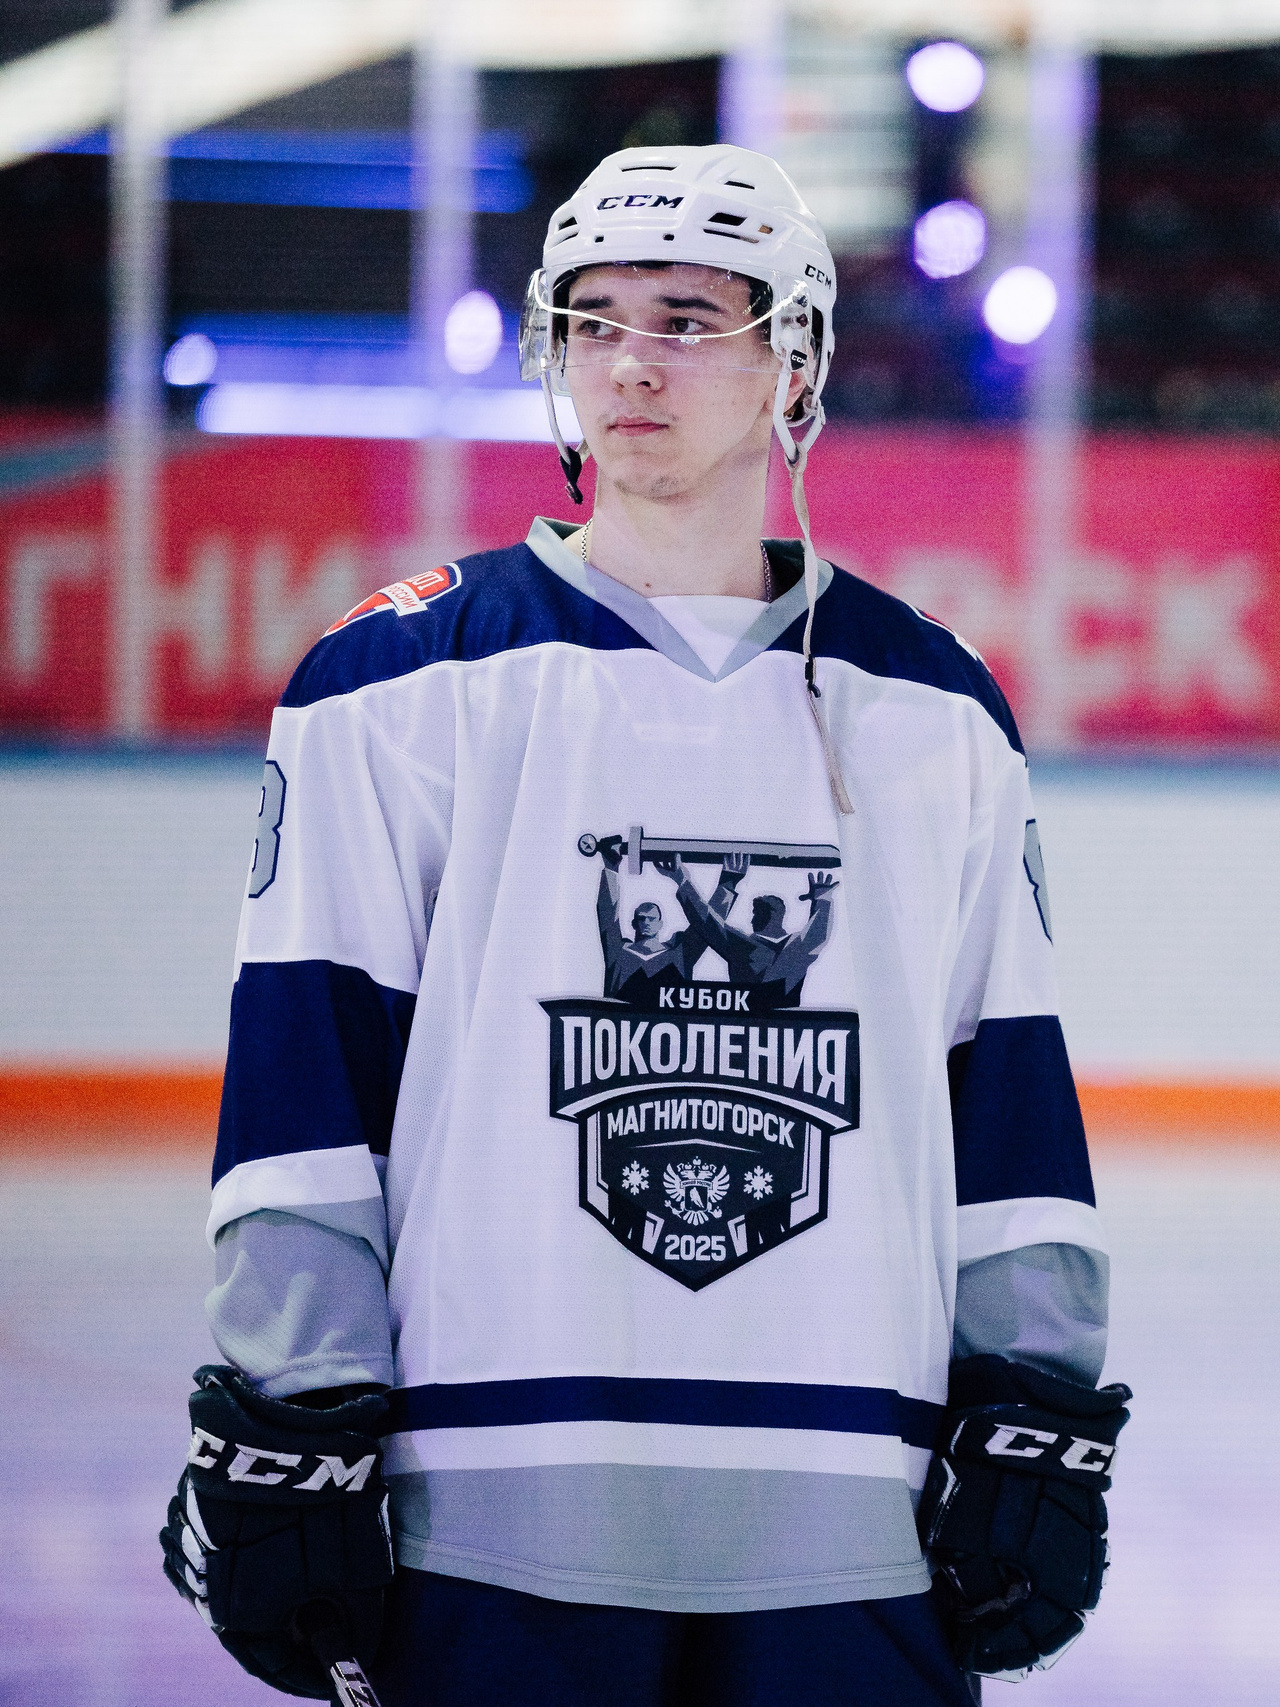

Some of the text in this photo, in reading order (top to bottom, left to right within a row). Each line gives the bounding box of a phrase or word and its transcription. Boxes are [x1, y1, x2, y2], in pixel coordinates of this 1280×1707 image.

[596, 194, 685, 211] CCM
[804, 262, 832, 291] CCM
[658, 986, 751, 1012] КУБОК
[559, 1015, 852, 1106] ПОКОЛЕНИЯ
[606, 1098, 797, 1149] МАГНИТОГОРСК
[664, 1233, 727, 1262] 2025
[187, 1426, 377, 1492] CCM
[984, 1422, 1120, 1477] CC
